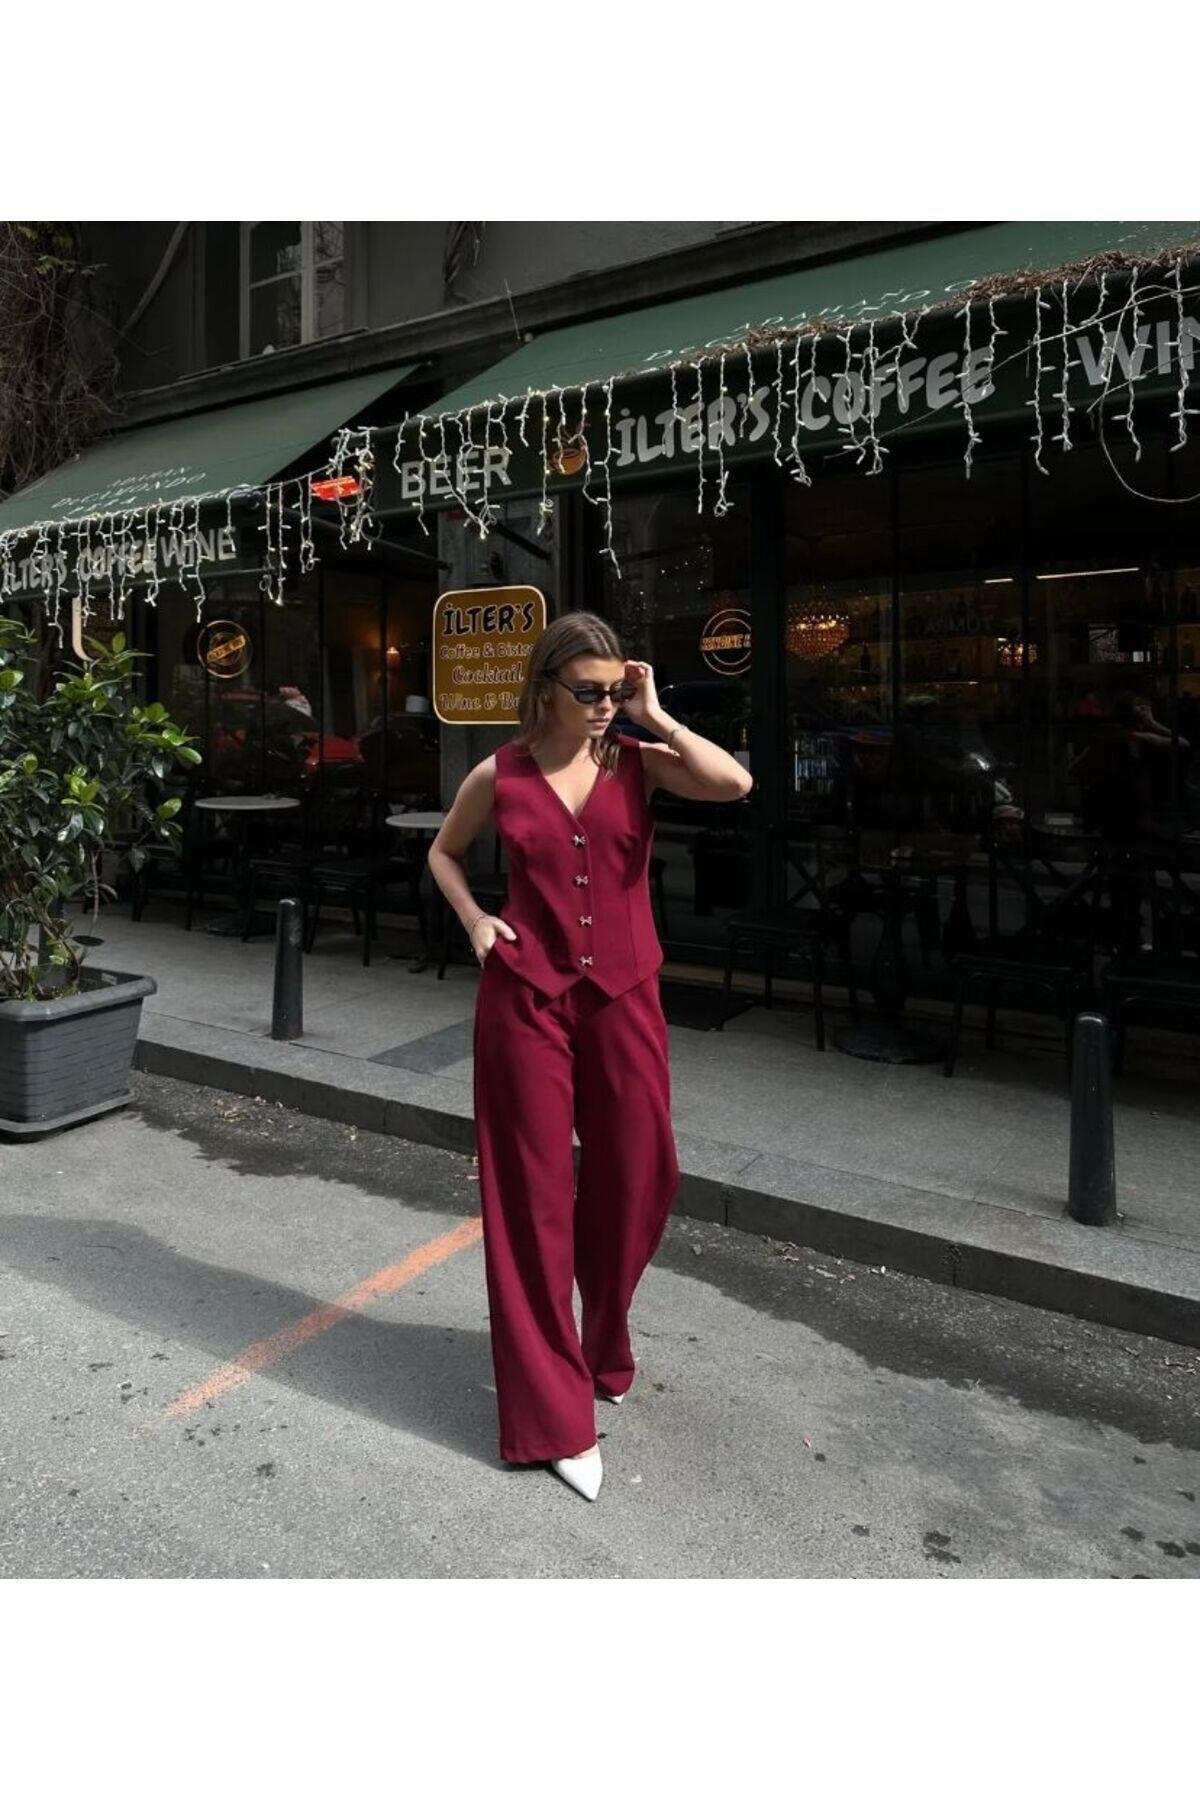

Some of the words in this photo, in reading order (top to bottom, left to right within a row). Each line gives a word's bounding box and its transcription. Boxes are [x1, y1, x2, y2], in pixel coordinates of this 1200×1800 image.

[401, 448, 512, 499] BEER
[800, 346, 997, 431] COFFEE
[160, 525, 237, 568] WINE
[442, 602, 535, 636] İLTER'S
[440, 644, 480, 660] Coffee
[483, 642, 495, 657] &
[452, 661, 524, 685] Cocktail
[439, 693, 482, 712] Wine
[484, 692, 498, 710] &
